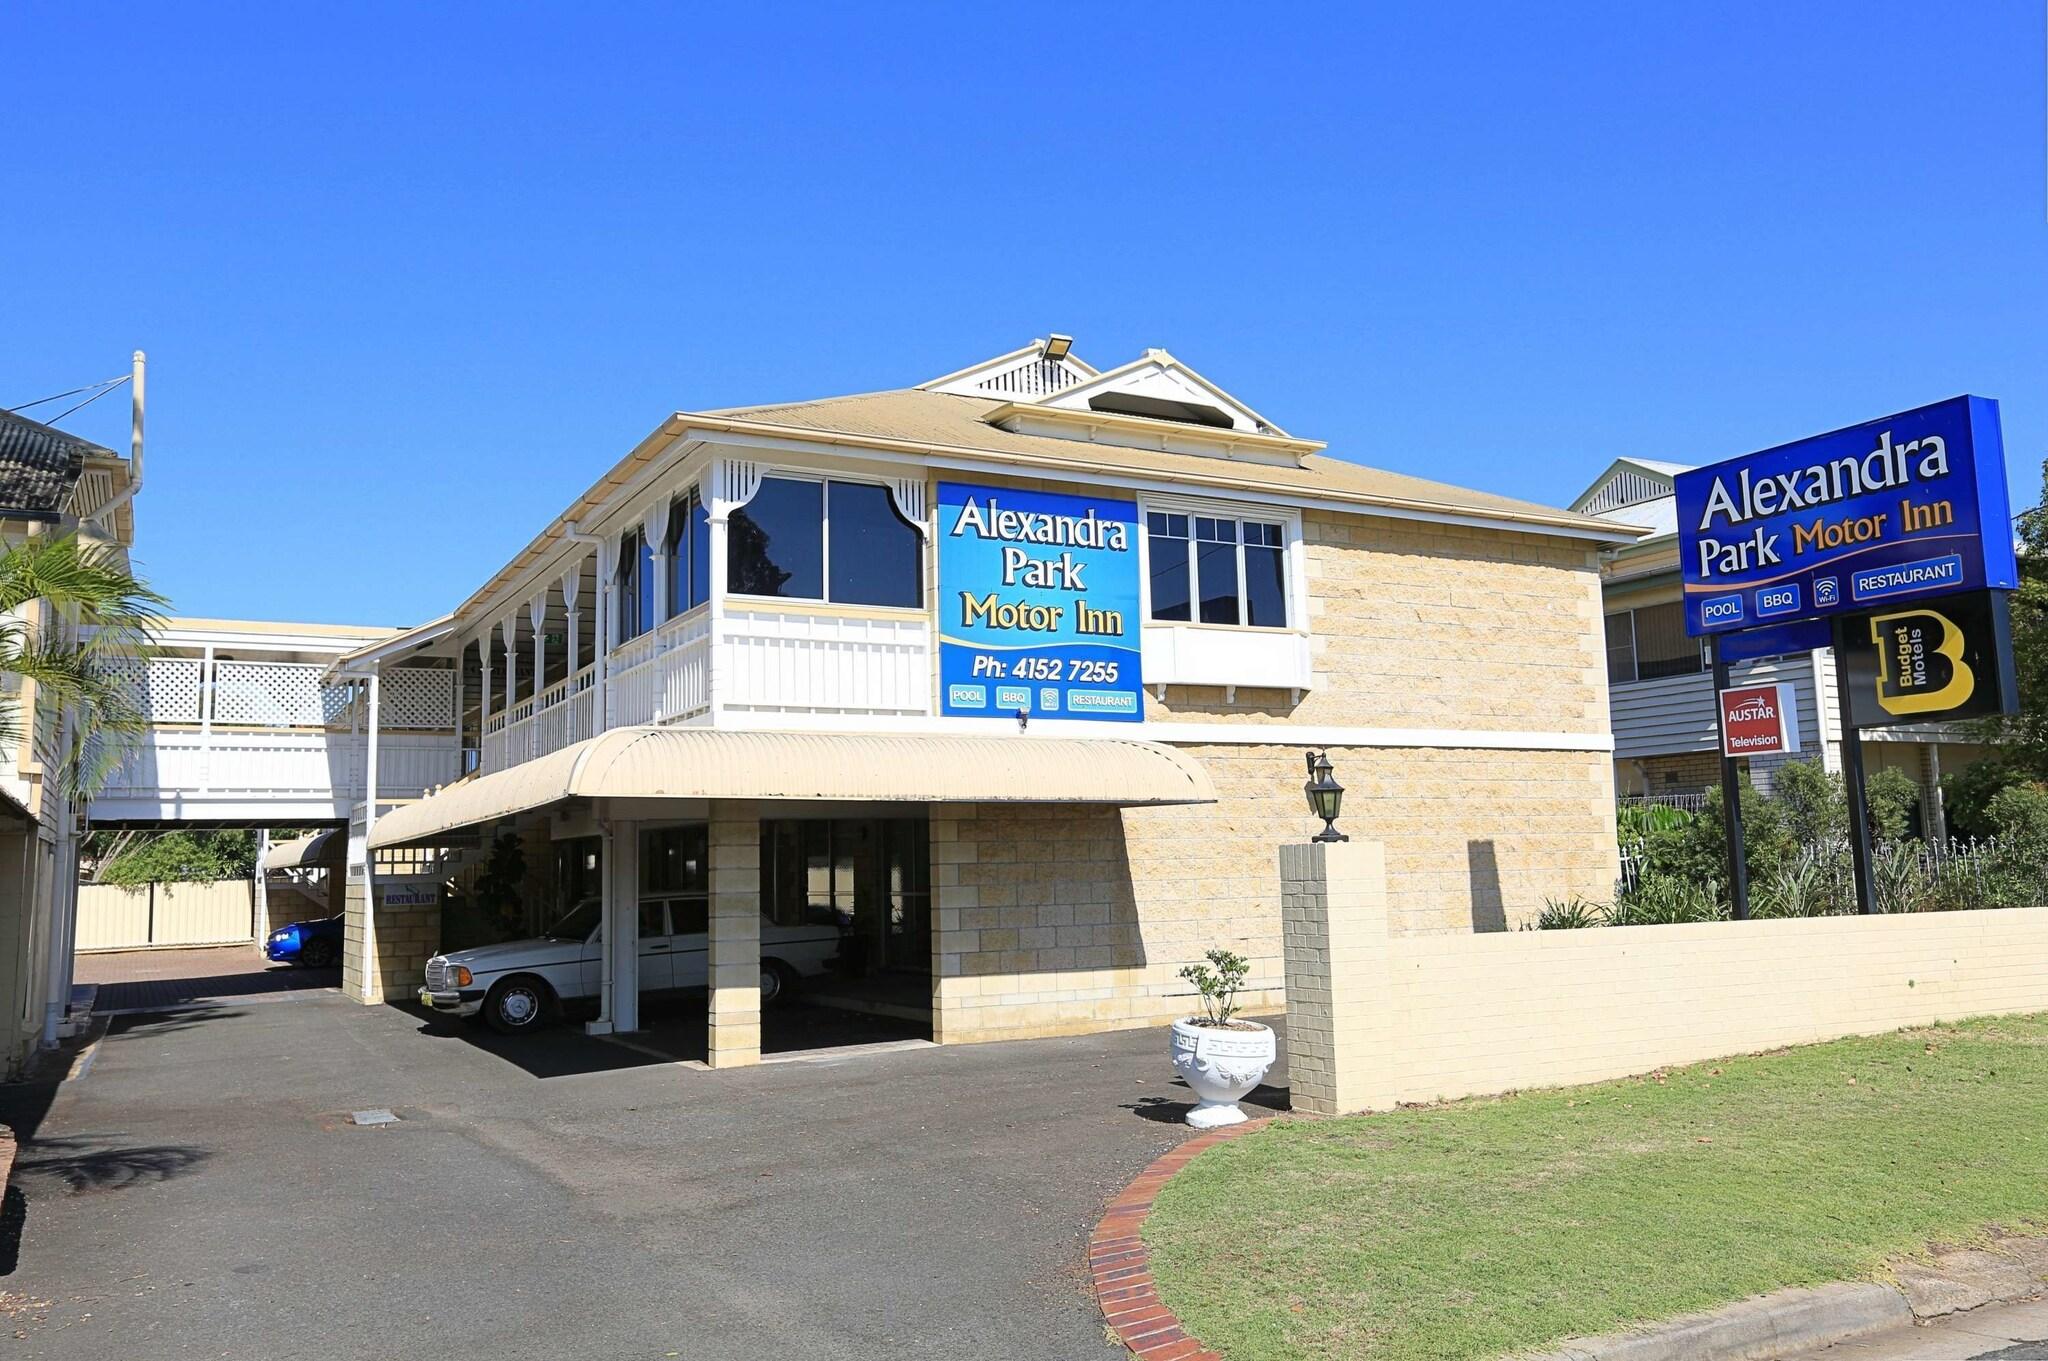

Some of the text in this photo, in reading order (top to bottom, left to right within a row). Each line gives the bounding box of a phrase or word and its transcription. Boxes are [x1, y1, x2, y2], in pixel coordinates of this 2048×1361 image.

[1699, 430, 1949, 530] Alexandra
[951, 496, 1128, 551] Alexandra
[1699, 500, 1953, 578] Park Motor Inn
[1003, 547, 1087, 591] Park
[1859, 563, 1956, 592] RESTAURANT
[1763, 591, 1794, 608] BBQ
[1819, 594, 1836, 603] Wi-Fi
[961, 592, 1123, 636] Motor Inn
[1705, 604, 1740, 618] POOL
[1895, 626, 1912, 687] Budget
[1910, 628, 1927, 686] Motels
[972, 655, 1119, 684] Ph: 4152 7255
[952, 690, 984, 702] POOL
[1002, 691, 1026, 704] BBQ
[1072, 695, 1133, 708] RESTAURANT
[1728, 706, 1774, 722] AUSTAR
[1730, 734, 1778, 748] Television
[386, 894, 436, 904] RESTAURANT
